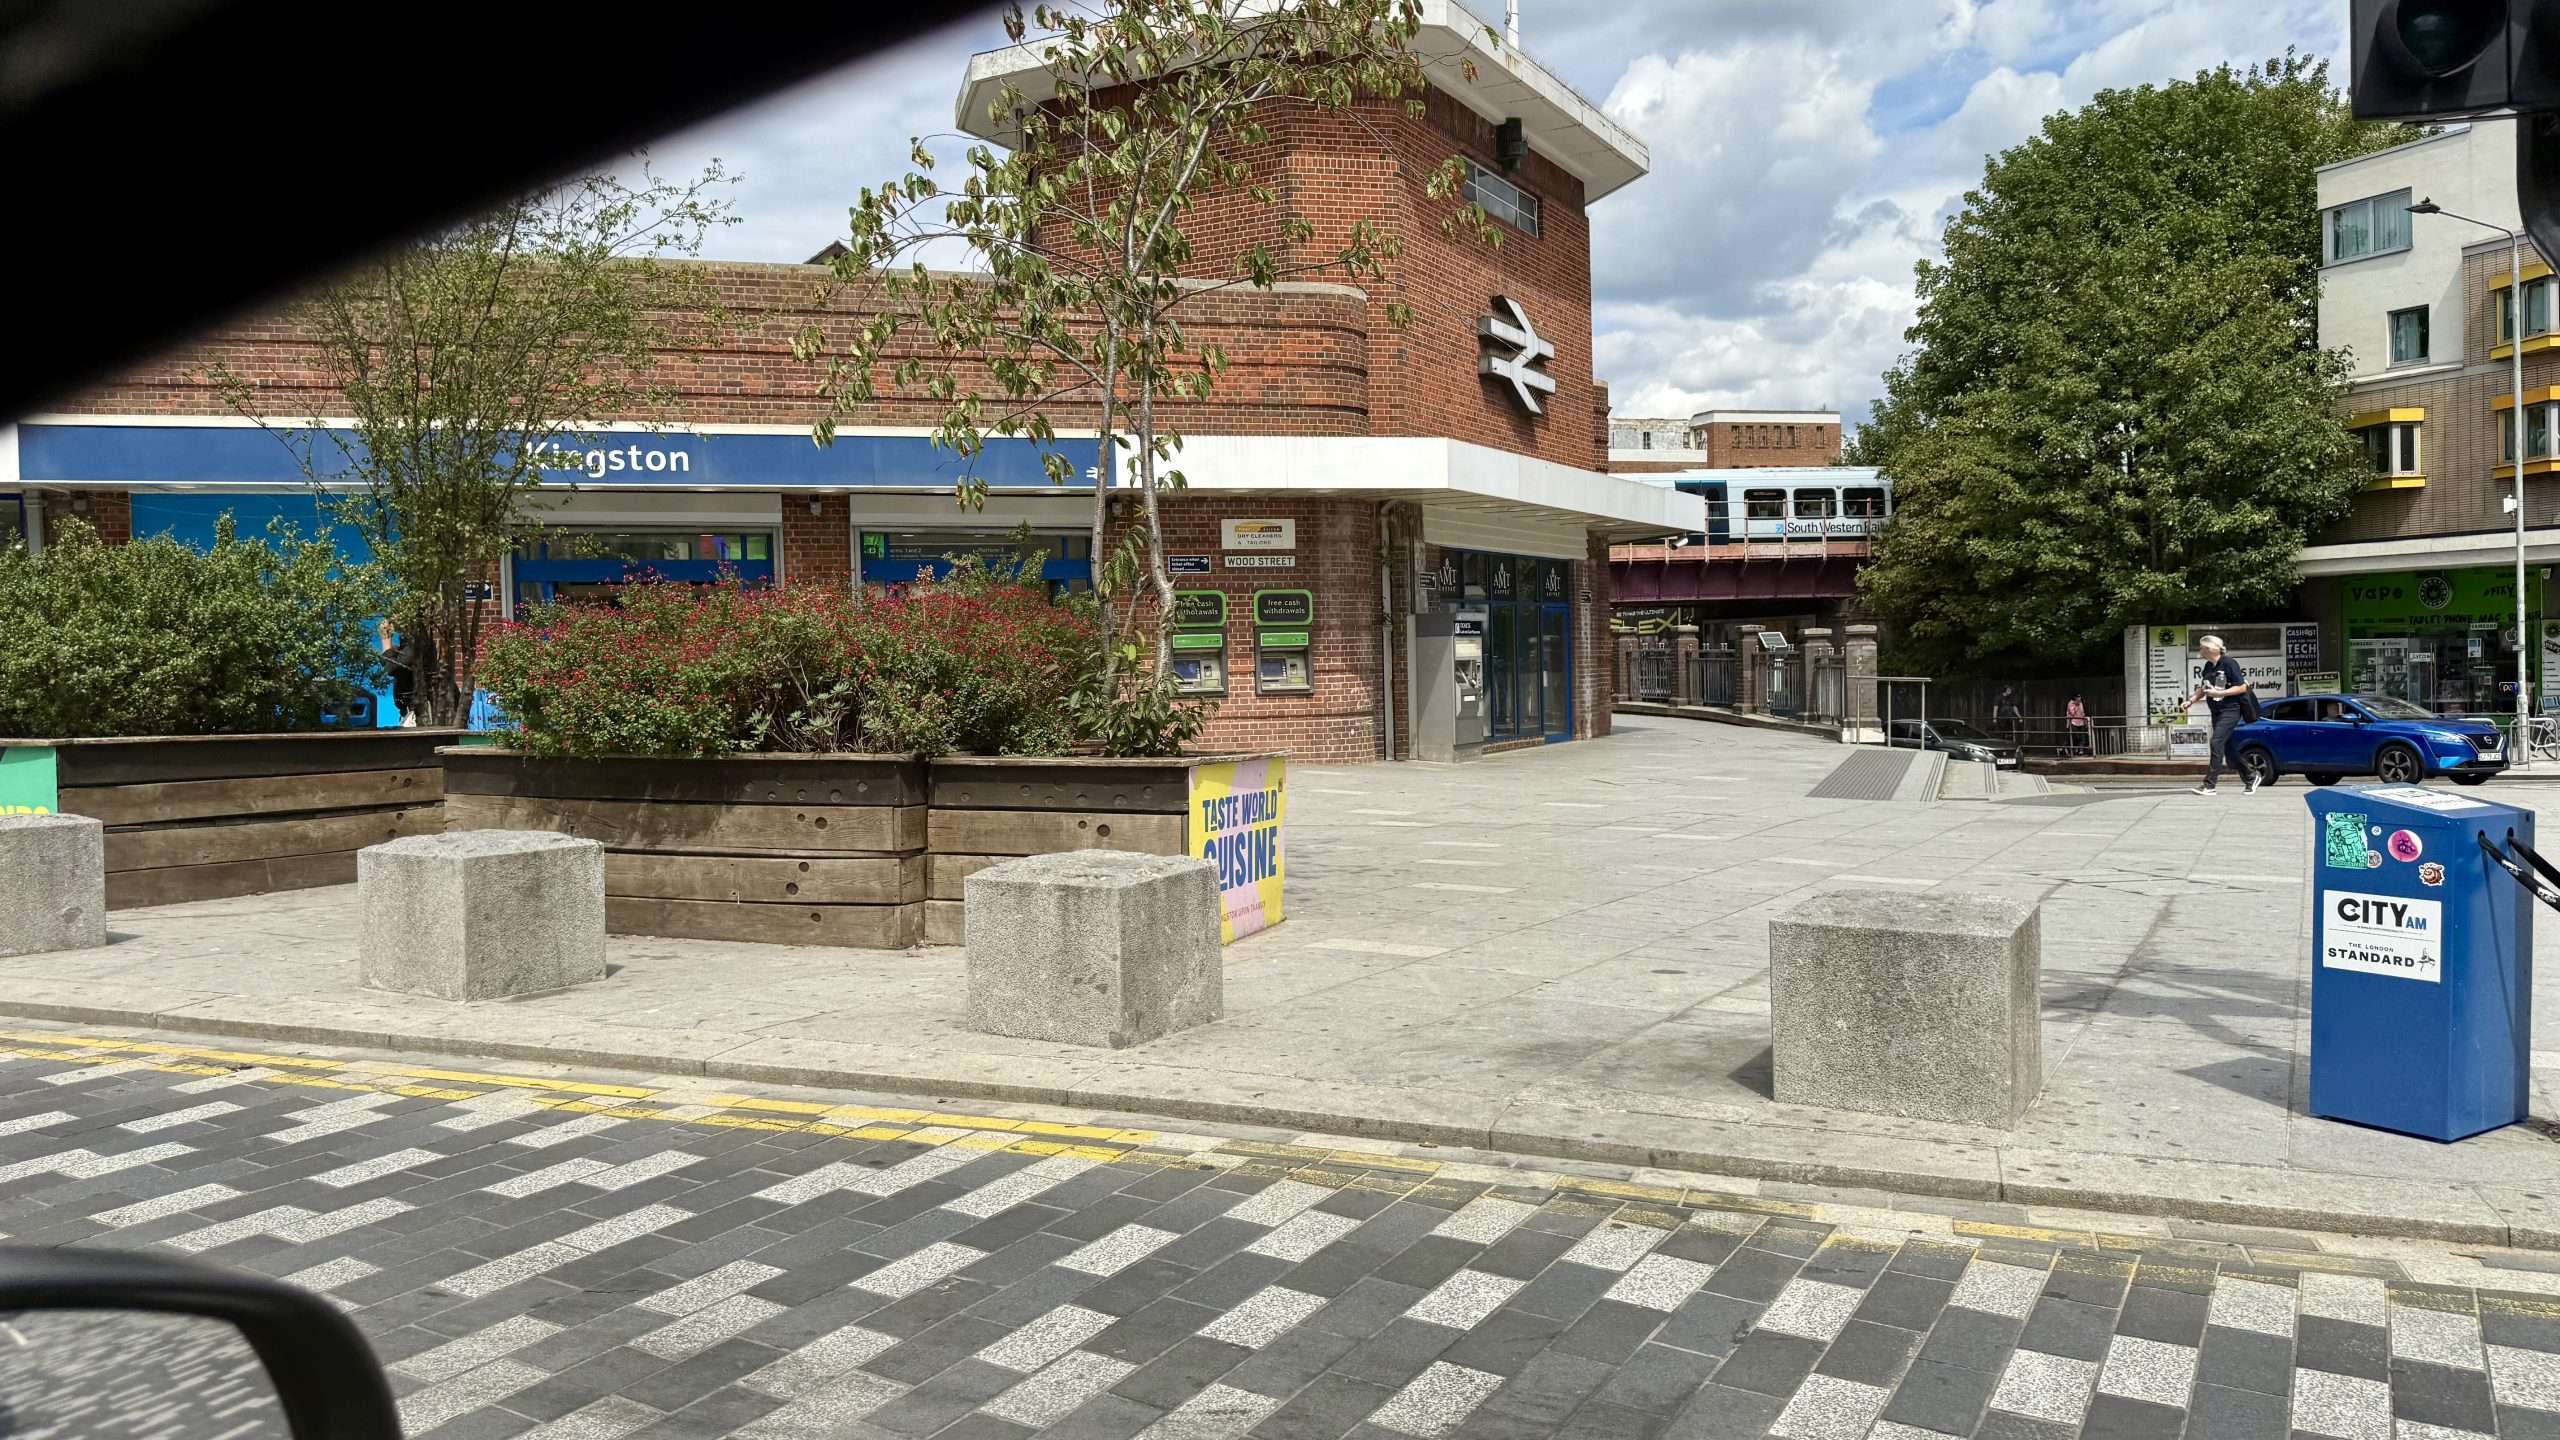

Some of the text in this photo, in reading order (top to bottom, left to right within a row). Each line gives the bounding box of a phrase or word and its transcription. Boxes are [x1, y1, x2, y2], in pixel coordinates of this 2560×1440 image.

[1787, 522, 1818, 533] South
[1819, 522, 1863, 533] Western
[1227, 556, 1293, 567] WOOD STREET
[1493, 571, 1511, 589] AMT
[1545, 574, 1561, 591] AMT
[1263, 606, 1306, 615] withdrawals
[2408, 615, 2441, 624] TABLET
[2444, 614, 2473, 623] PHONE
[2287, 643, 2317, 654] TECH
[2248, 667, 2264, 677] Piri
[2266, 666, 2282, 676] Piri
[2255, 682, 2282, 691] healthy
[1202, 789, 1278, 833] TASTE WORLD
[2337, 898, 2408, 928] CITY
[2405, 916, 2427, 930] AM
[2365, 944, 2394, 953] LONDON
[2327, 947, 2415, 967] STANDARD
